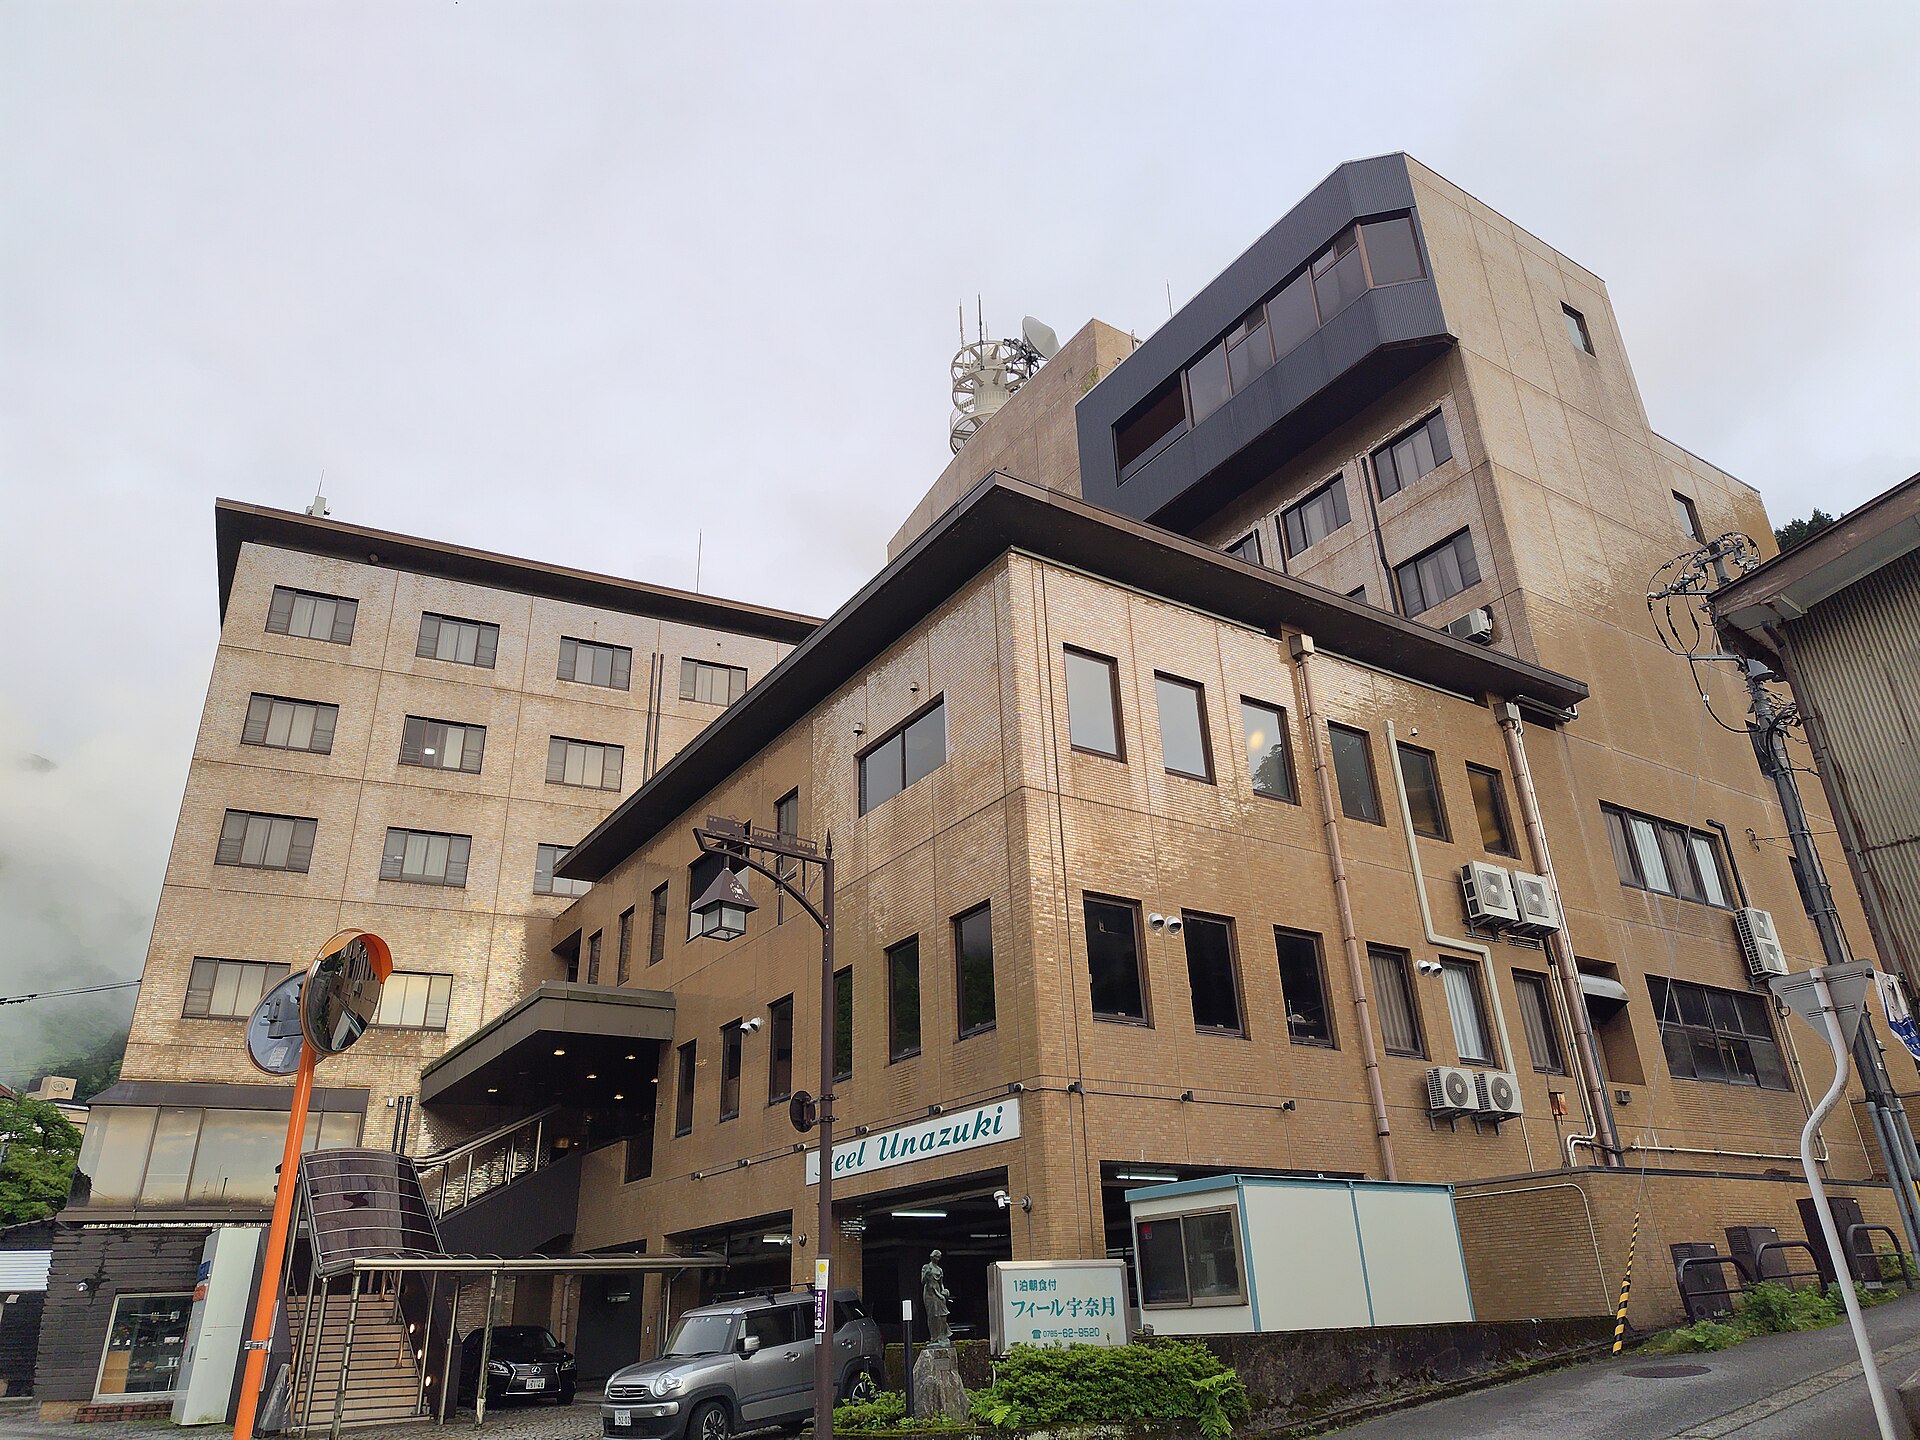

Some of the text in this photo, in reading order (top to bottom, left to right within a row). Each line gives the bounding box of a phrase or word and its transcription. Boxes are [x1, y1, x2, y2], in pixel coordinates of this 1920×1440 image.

[877, 1105, 1004, 1162] Unazuki
[1013, 1279, 1057, 1292] 1泊朝食付
[1010, 1296, 1116, 1319] フィール宇奈月
